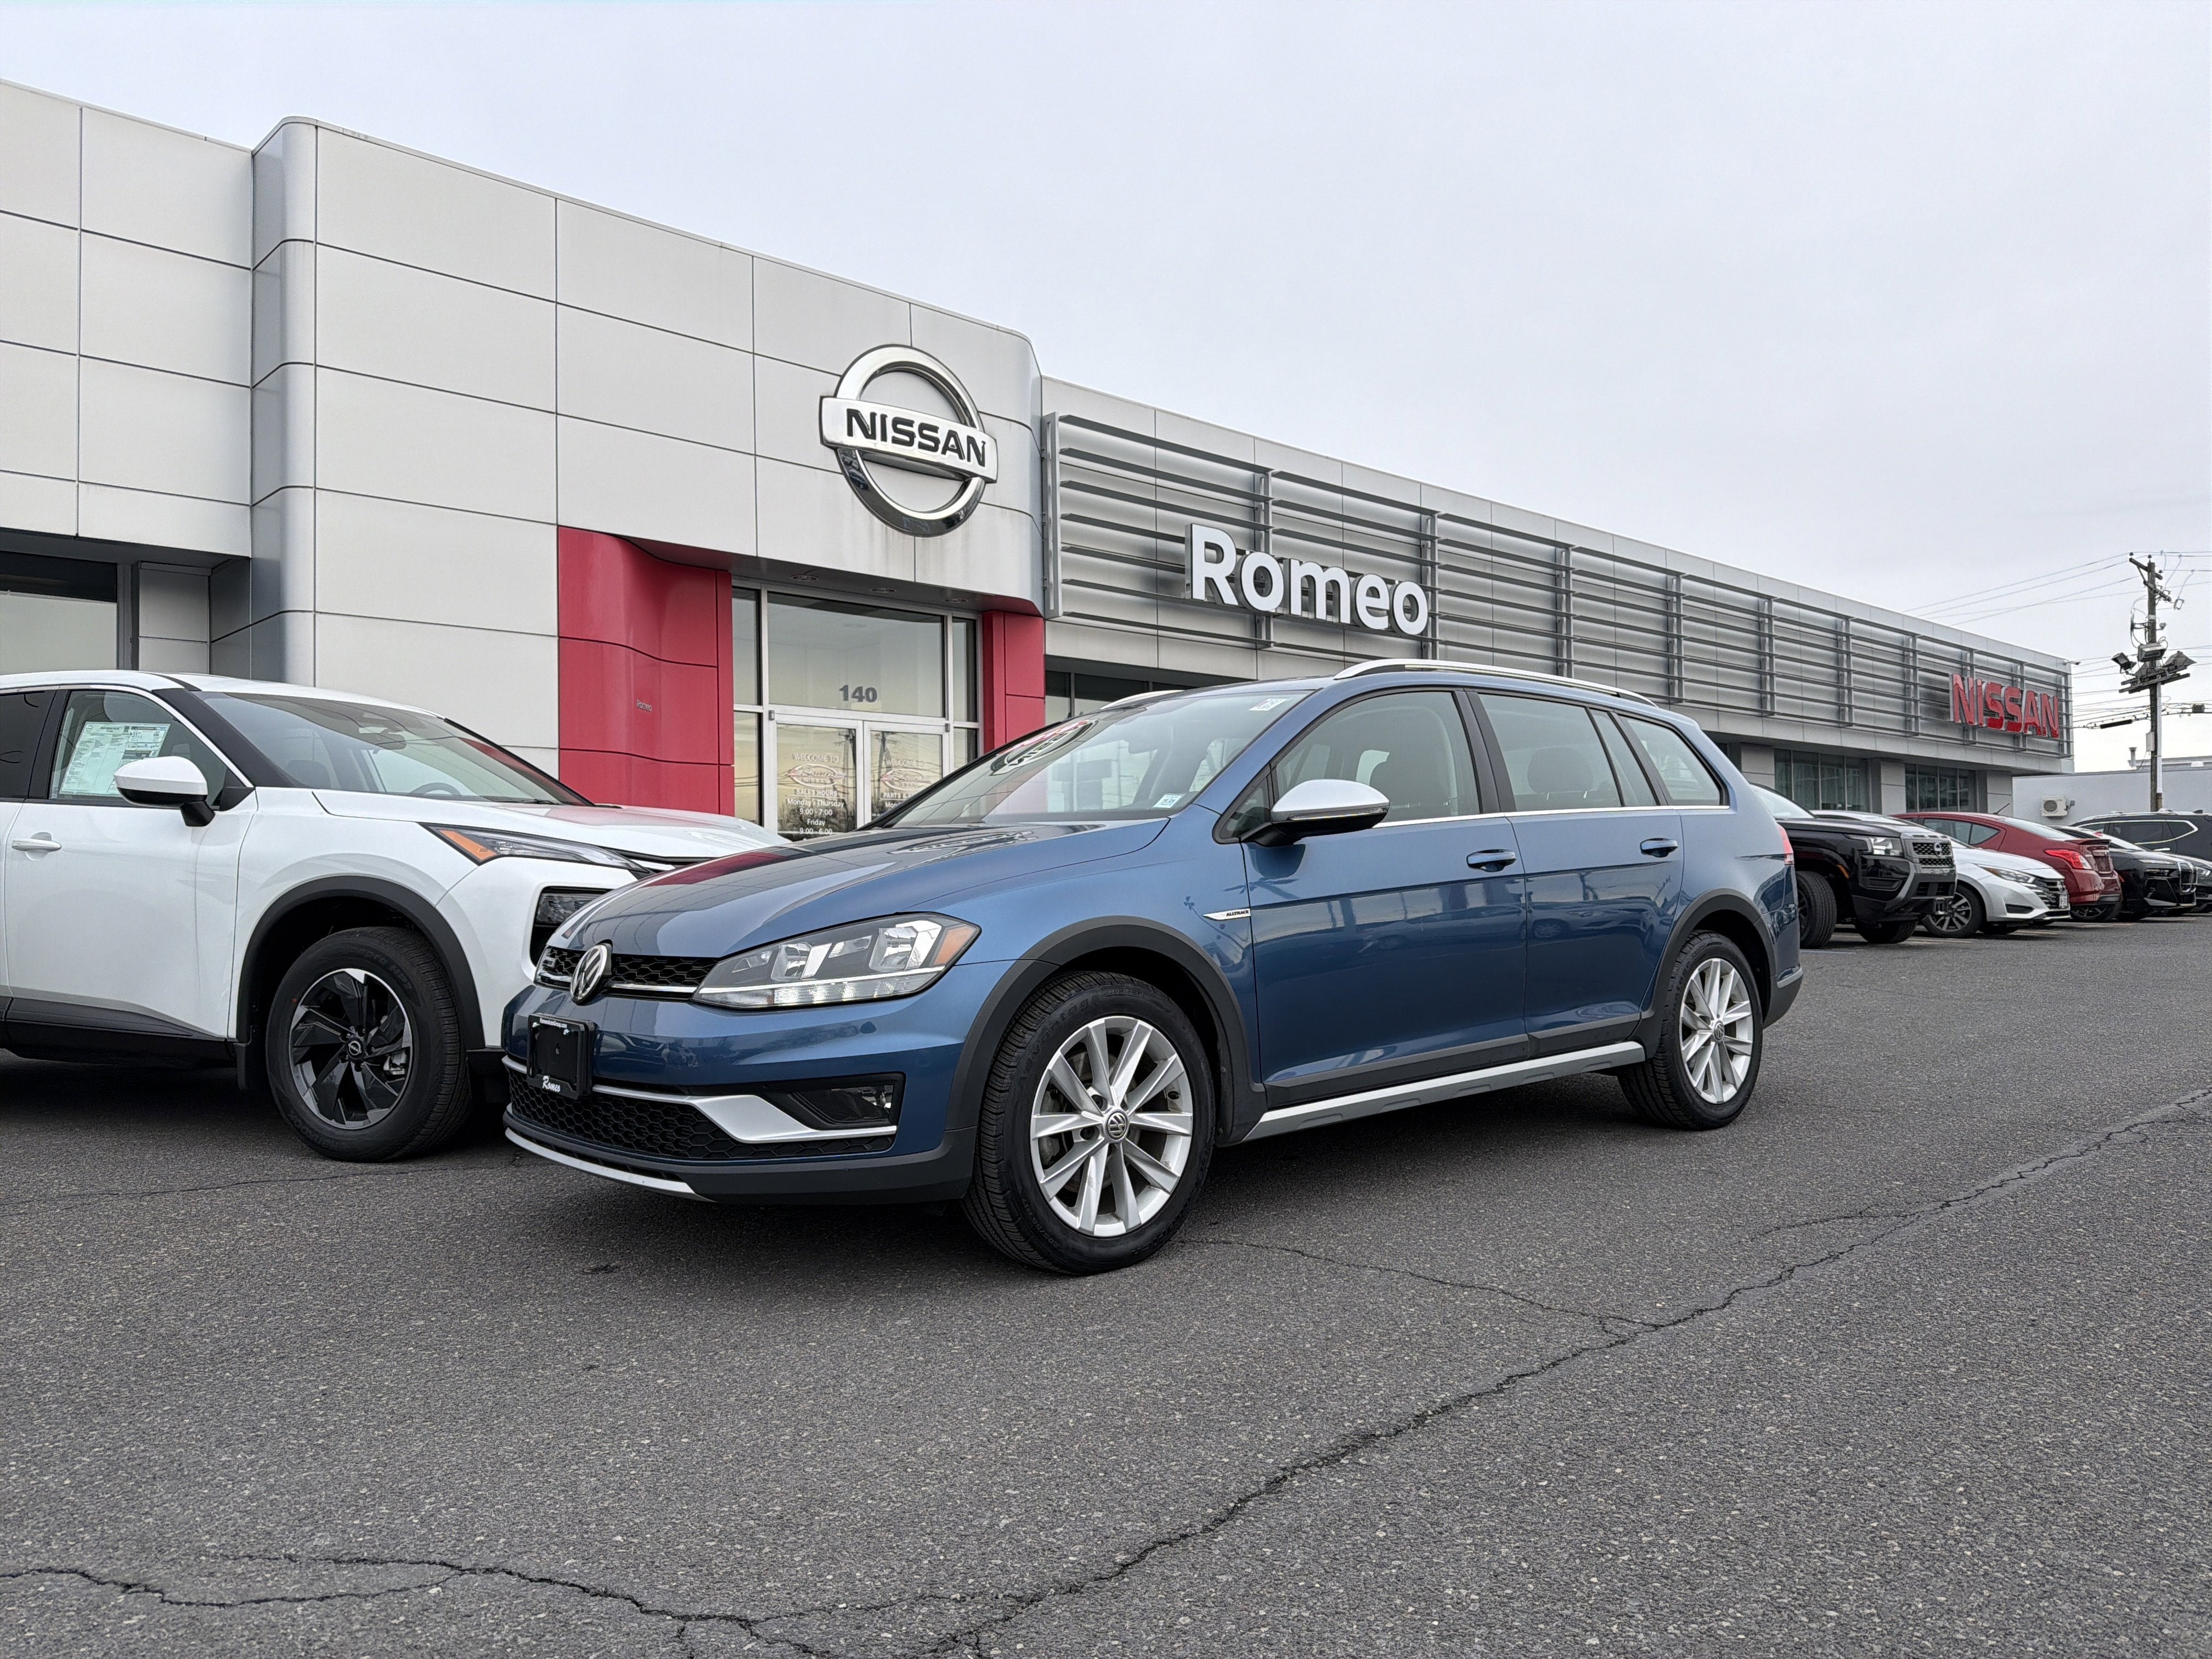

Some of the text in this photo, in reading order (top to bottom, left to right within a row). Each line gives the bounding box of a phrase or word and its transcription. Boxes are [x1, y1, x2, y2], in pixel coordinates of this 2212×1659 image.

[846, 408, 986, 467] NISSAN
[1185, 522, 1429, 636] Romeo
[839, 684, 878, 703] 140
[636, 699, 652, 712] Romeo
[1950, 673, 2059, 738] NISSAN
[794, 753, 829, 762] WELCOME
[787, 798, 811, 807] Monday
[817, 799, 844, 808] Thursday
[807, 819, 826, 827] Friday
